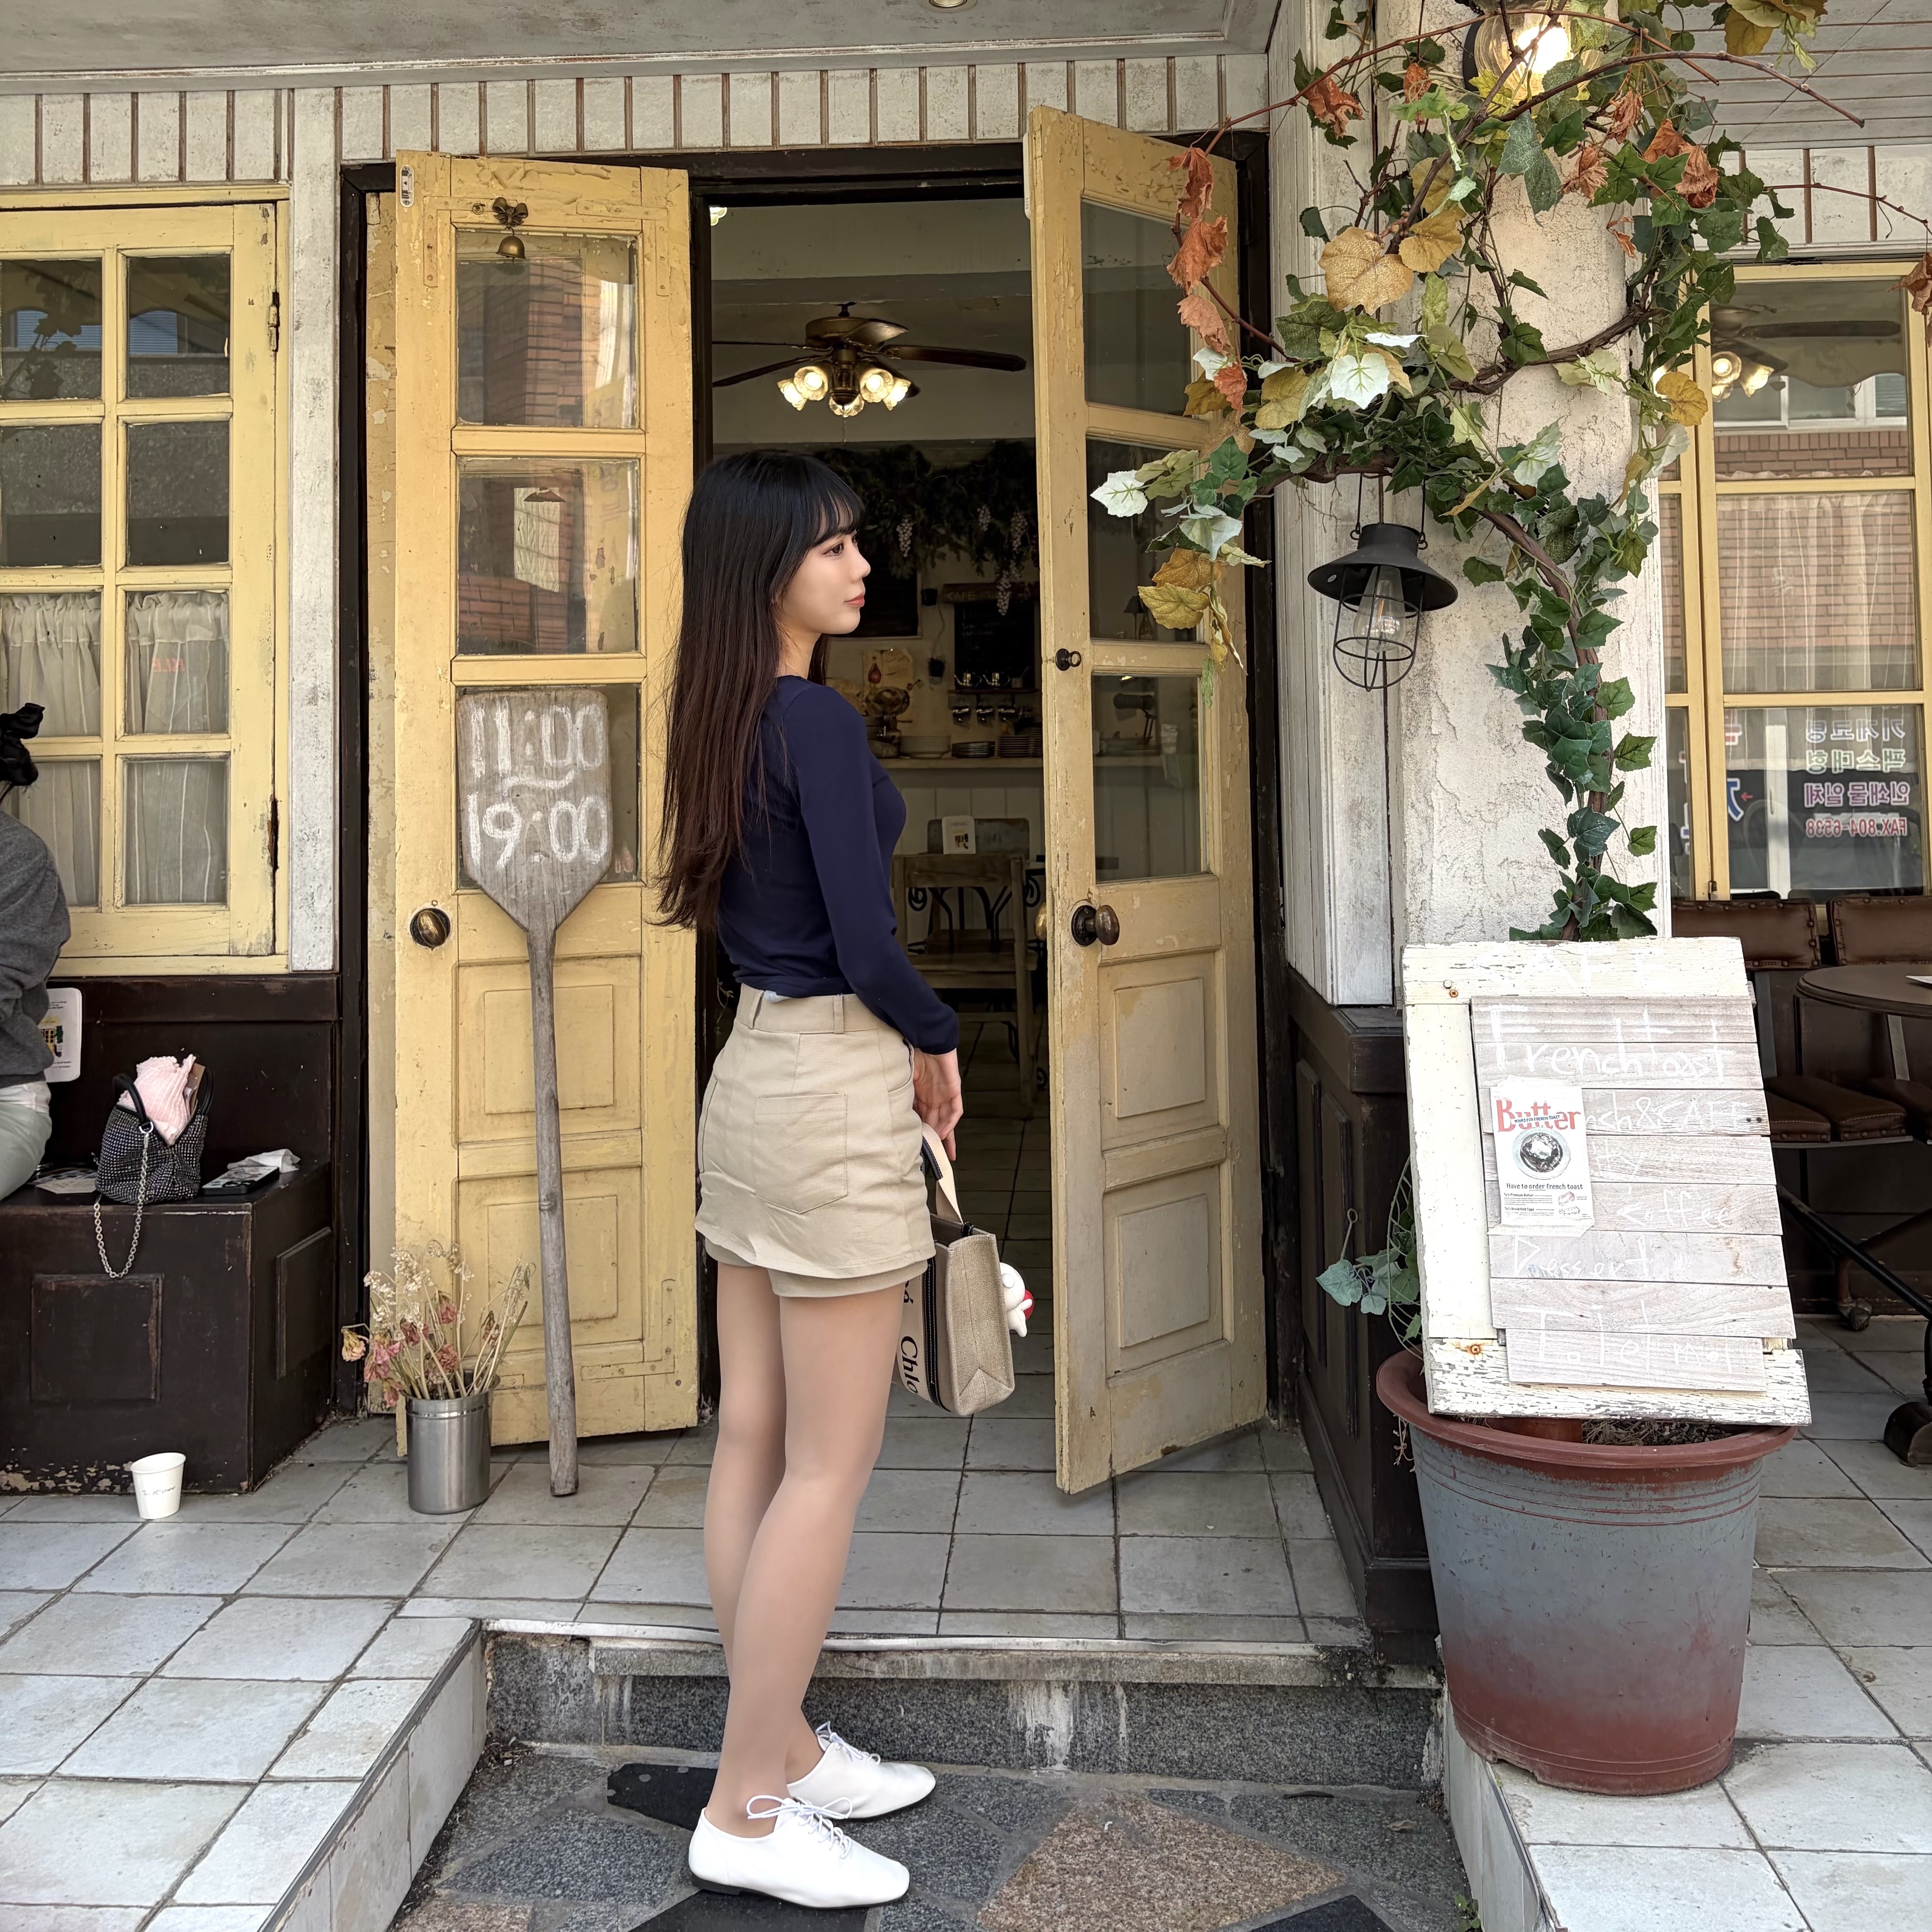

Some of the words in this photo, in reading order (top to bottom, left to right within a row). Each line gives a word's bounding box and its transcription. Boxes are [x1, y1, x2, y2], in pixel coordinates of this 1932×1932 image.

[470, 699, 604, 778] 11:00
[467, 792, 608, 870] 19:00
[1496, 1096, 1581, 1132] Butter
[1512, 1234, 1655, 1282] Dessert
[901, 1336, 920, 1394] Chlo
